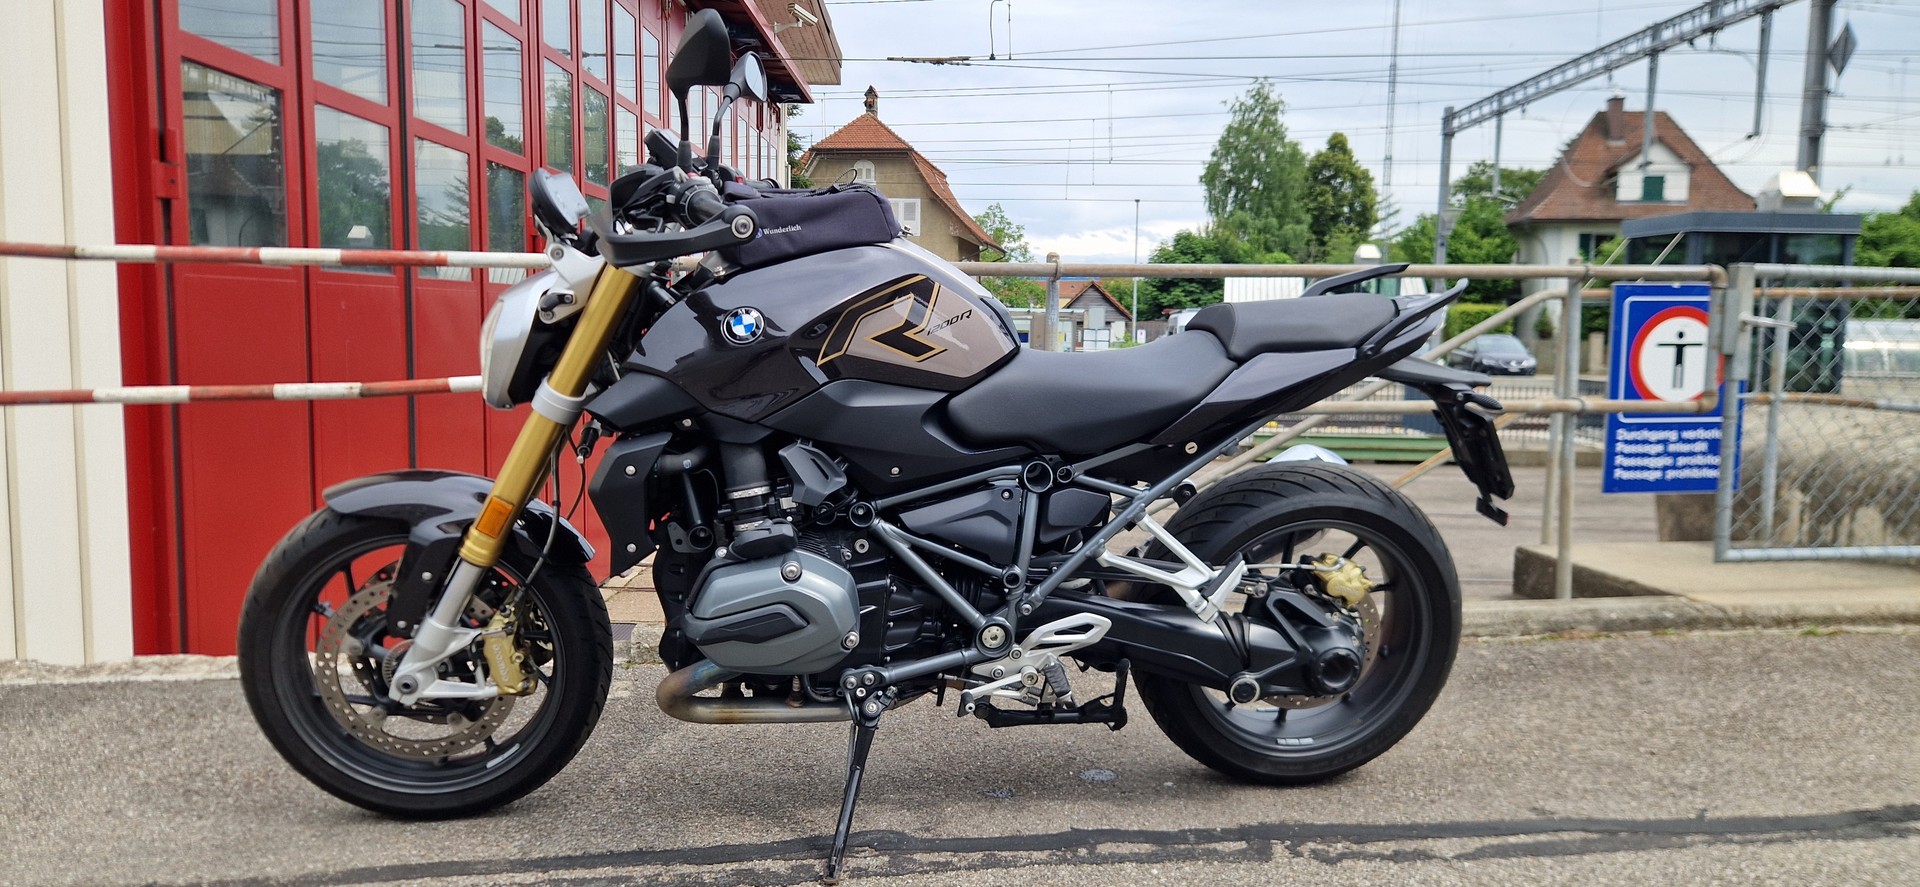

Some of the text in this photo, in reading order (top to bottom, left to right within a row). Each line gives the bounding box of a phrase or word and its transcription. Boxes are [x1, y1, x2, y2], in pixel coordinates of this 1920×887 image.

[762, 224, 802, 235] Wunderlich
[1616, 427, 1722, 442] Durchgang verbote
[1615, 441, 1709, 455] Passage interdit
[1614, 454, 1675, 468] Passaggio
[1613, 468, 1663, 482] Passage
